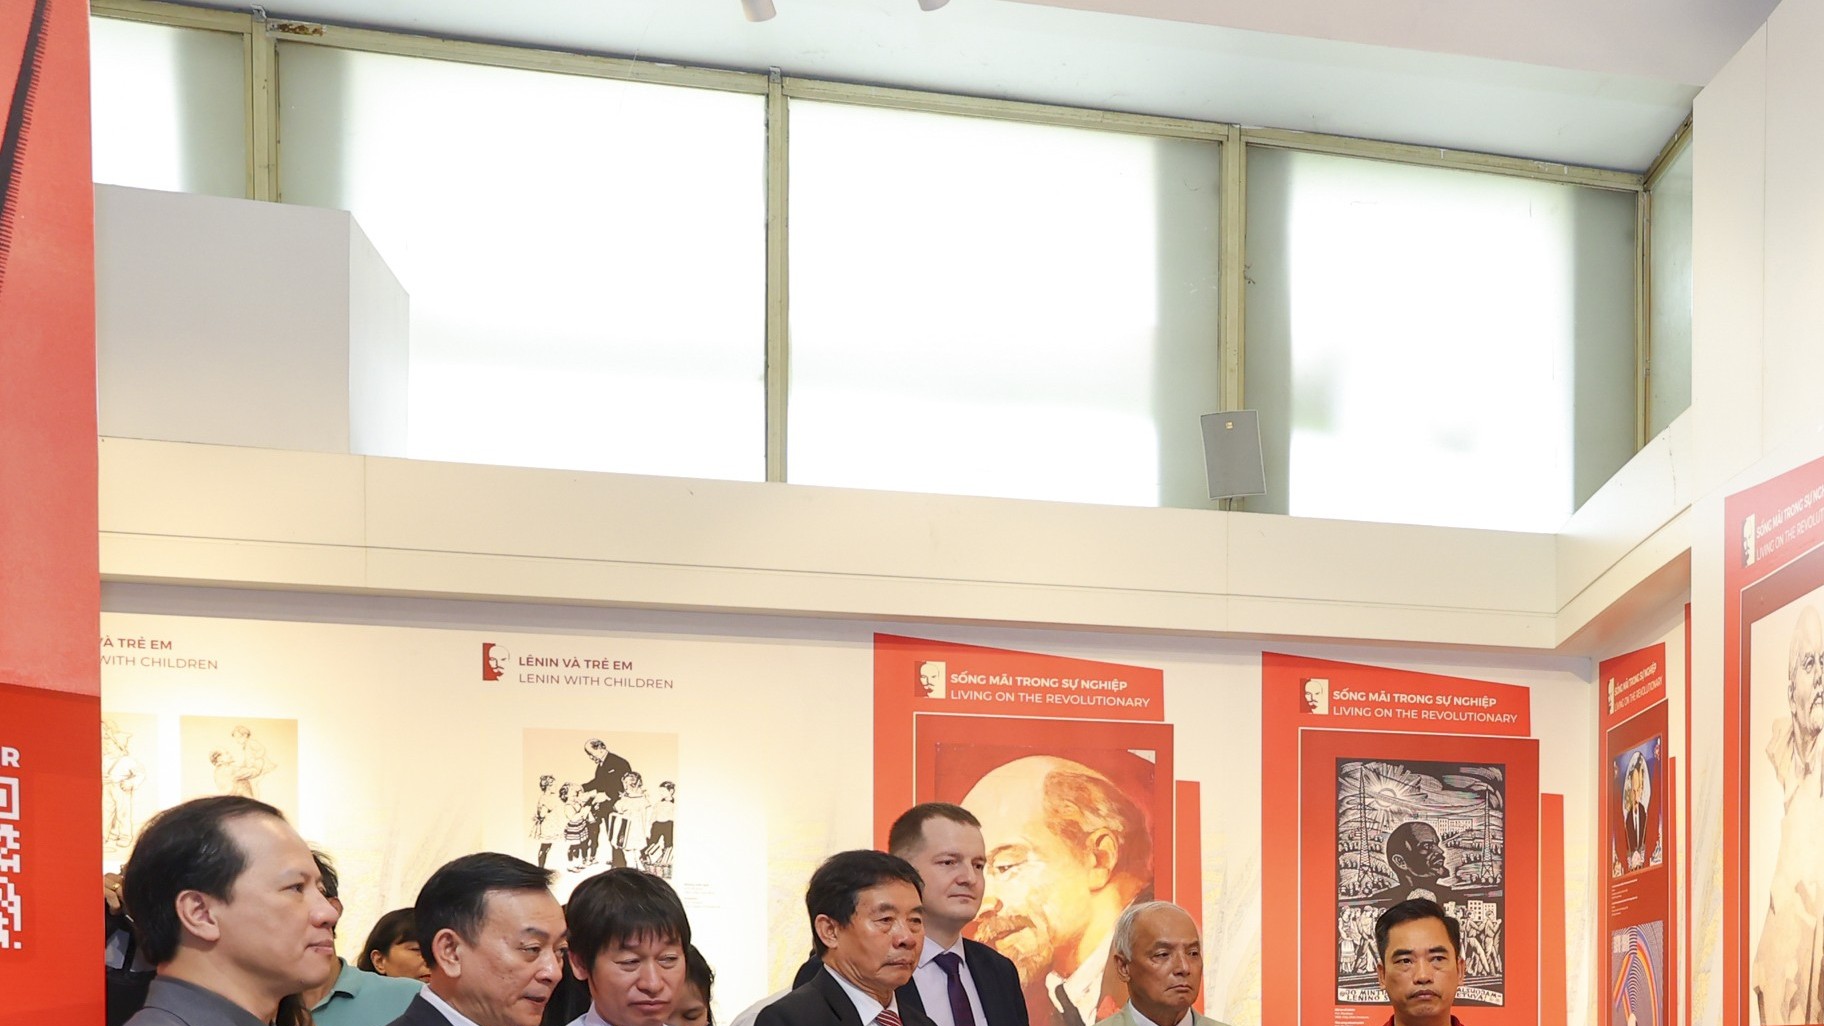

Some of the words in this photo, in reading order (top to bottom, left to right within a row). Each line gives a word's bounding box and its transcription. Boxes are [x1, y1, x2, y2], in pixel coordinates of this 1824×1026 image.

[151, 640, 172, 650] EM
[141, 657, 218, 669] CHILDREN
[519, 655, 558, 667] LÊNIN
[563, 657, 580, 668] VÀ
[613, 661, 633, 670] EM
[519, 673, 559, 684] LENIN
[564, 675, 599, 685] WITH
[604, 677, 673, 689] CHILDREN
[951, 671, 986, 684] SỐNG
[990, 674, 1012, 686] MÃI
[1016, 676, 1059, 688] TRONG
[1061, 678, 1080, 690] SỰ
[1081, 678, 1127, 691] NGHIỆP
[951, 690, 992, 701] LIVING
[996, 691, 1014, 701] ON
[1018, 693, 1042, 703] THE
[1048, 694, 1150, 707] REVOLUTIONARY
[1333, 688, 1366, 700] SỐNG
[1369, 691, 1390, 702] MÃI
[1393, 694, 1433, 704] TRONG
[1436, 695, 1452, 707] SỰ
[1454, 695, 1497, 708] NGHIỆP
[1333, 706, 1372, 716] LIVING
[1375, 708, 1392, 717] ON
[1396, 709, 1418, 718] THE
[1422, 710, 1517, 723] REVOLUTIONARY
